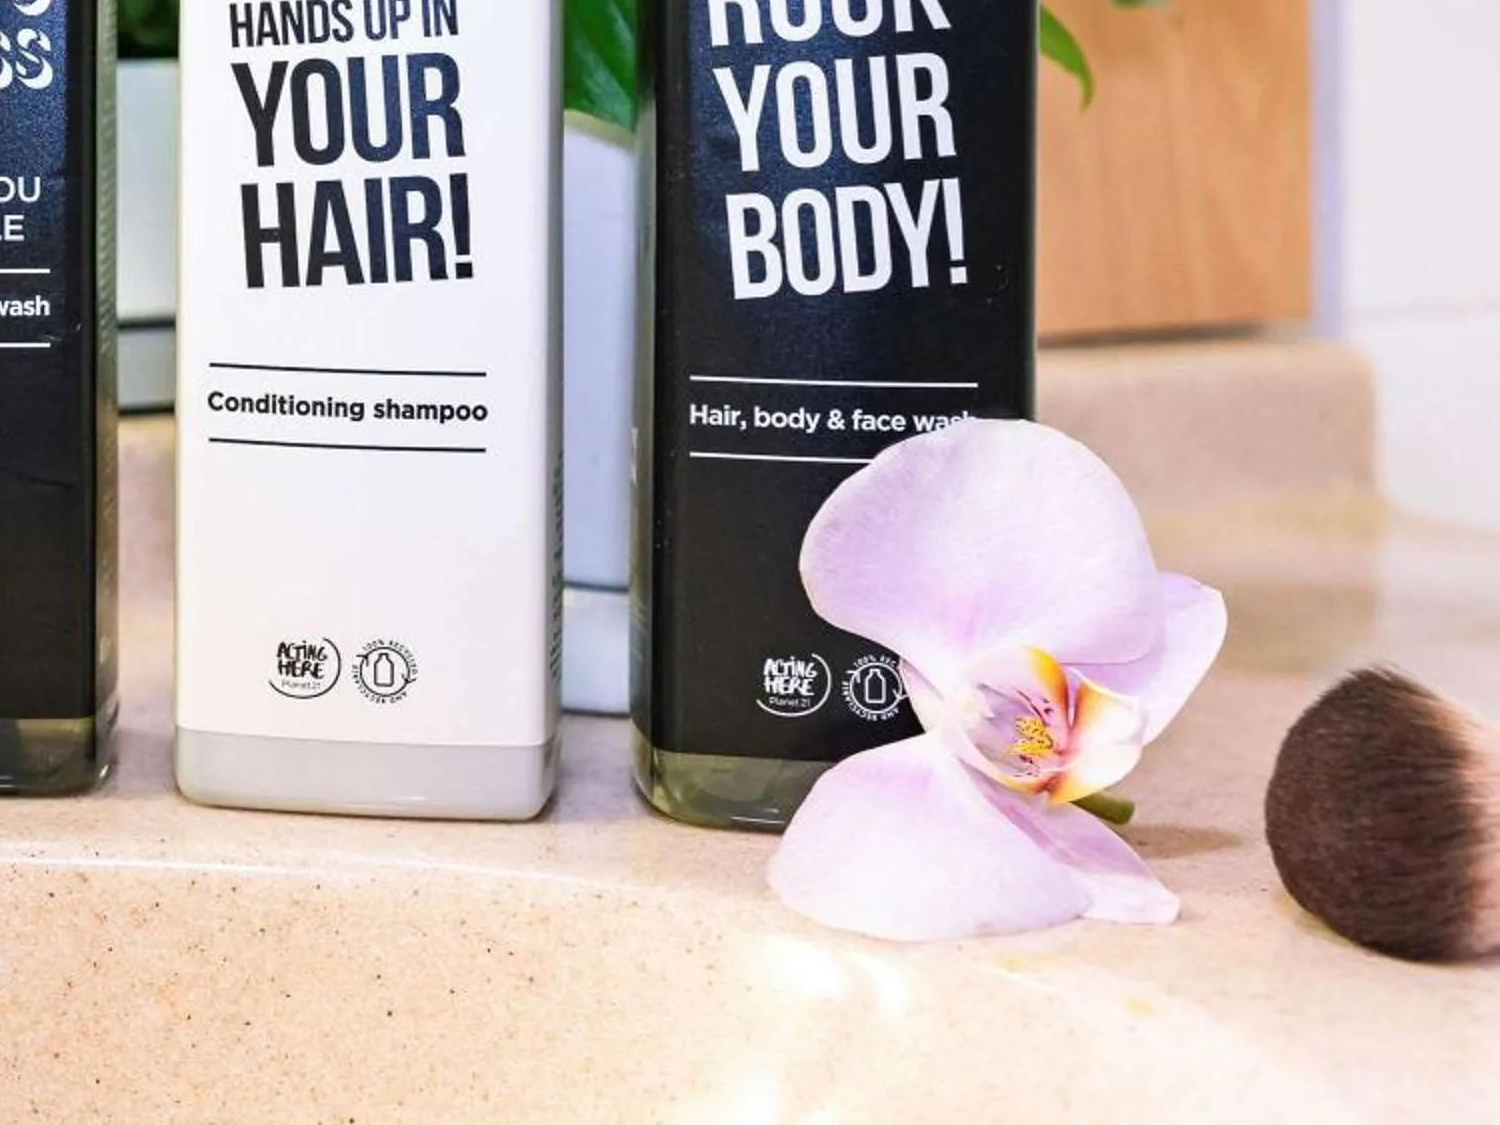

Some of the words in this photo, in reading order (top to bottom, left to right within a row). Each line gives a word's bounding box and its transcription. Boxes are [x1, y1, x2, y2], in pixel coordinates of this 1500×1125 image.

[231, 53, 465, 167] YOUR
[713, 53, 956, 171] YOUR
[241, 173, 473, 288] HAIR!
[726, 178, 966, 299] BODY!
[208, 391, 364, 421] Conditioning
[374, 399, 488, 424] shampoo
[690, 404, 746, 429] Hair,
[755, 407, 820, 433] body
[827, 409, 845, 429] &
[852, 409, 906, 431] face
[277, 660, 324, 679] HERE
[763, 676, 815, 696] HERE
